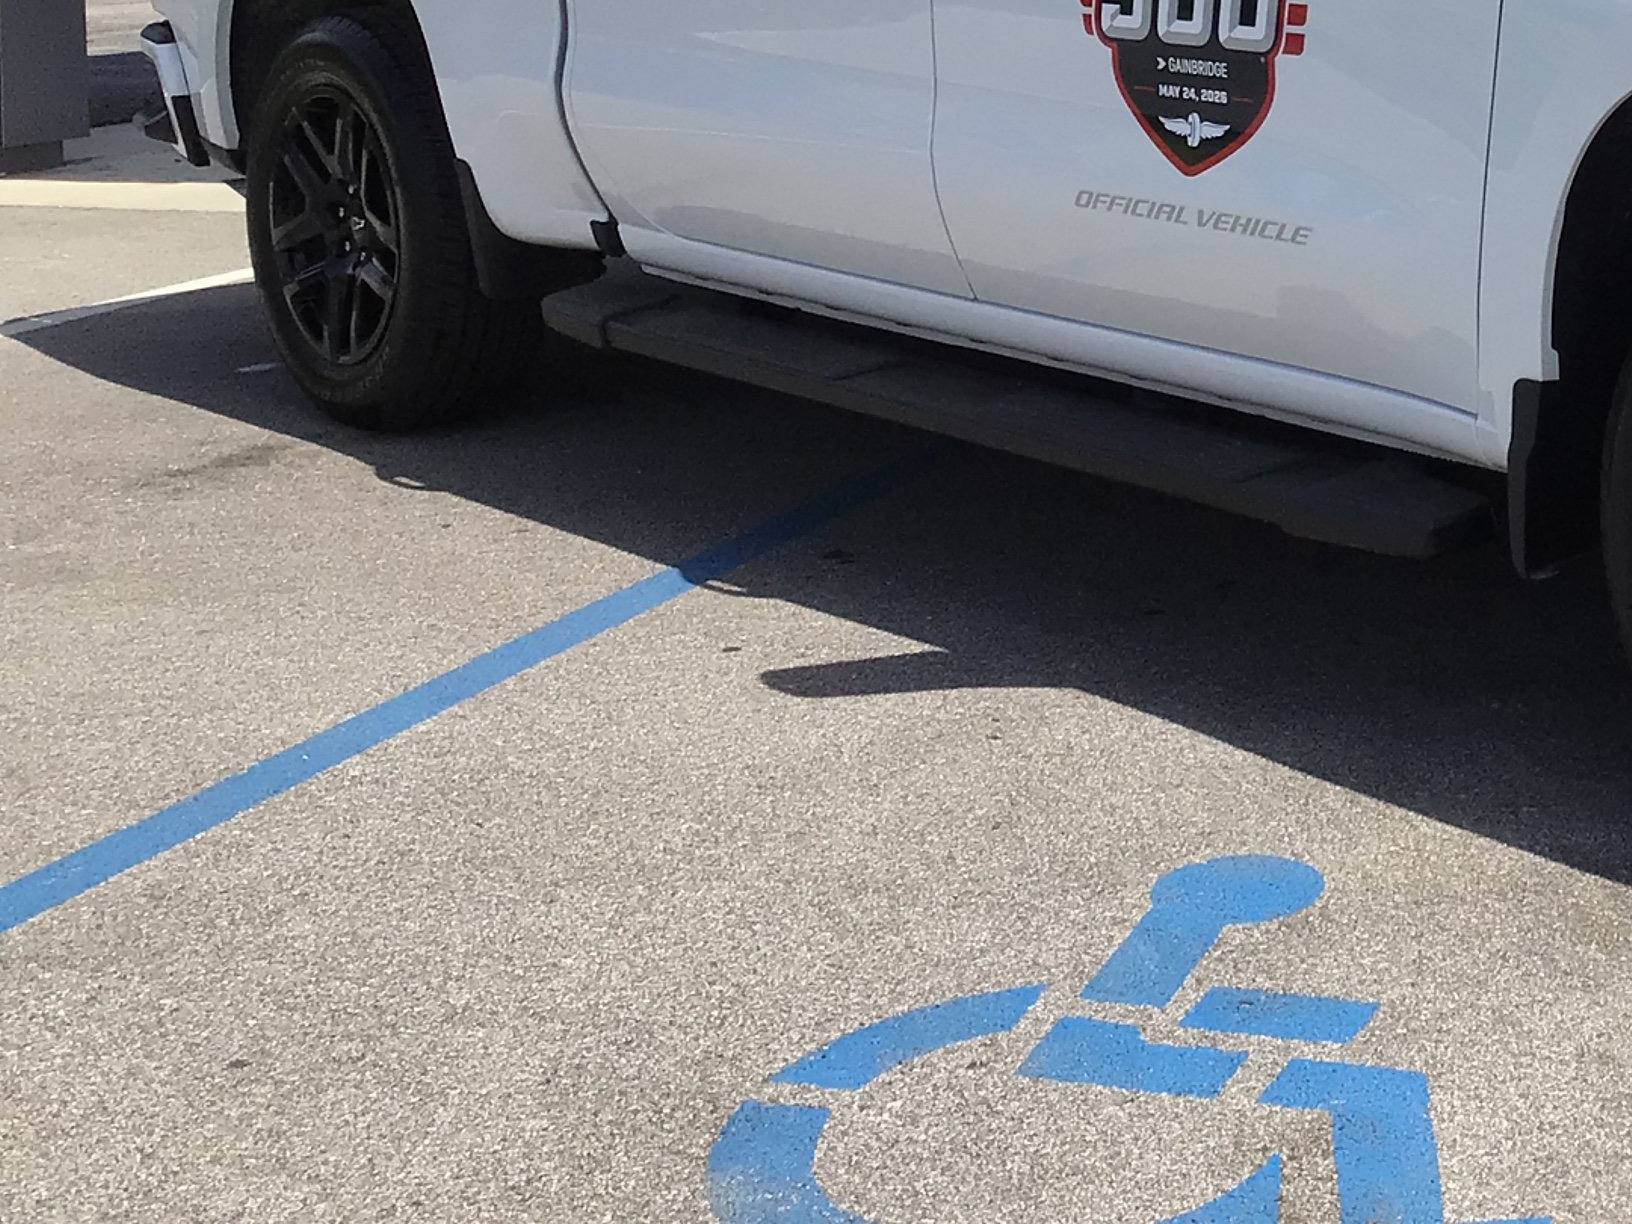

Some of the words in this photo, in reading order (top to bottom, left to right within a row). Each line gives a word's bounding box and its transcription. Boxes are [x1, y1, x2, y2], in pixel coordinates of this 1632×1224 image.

[1168, 57, 1228, 78] GAINBRIDGE
[1158, 84, 1181, 98] MAY
[1182, 86, 1199, 102] 24,
[1200, 88, 1228, 104] 2026
[1074, 189, 1188, 225] OFFICIAL
[1196, 209, 1313, 246] VEHICLE
